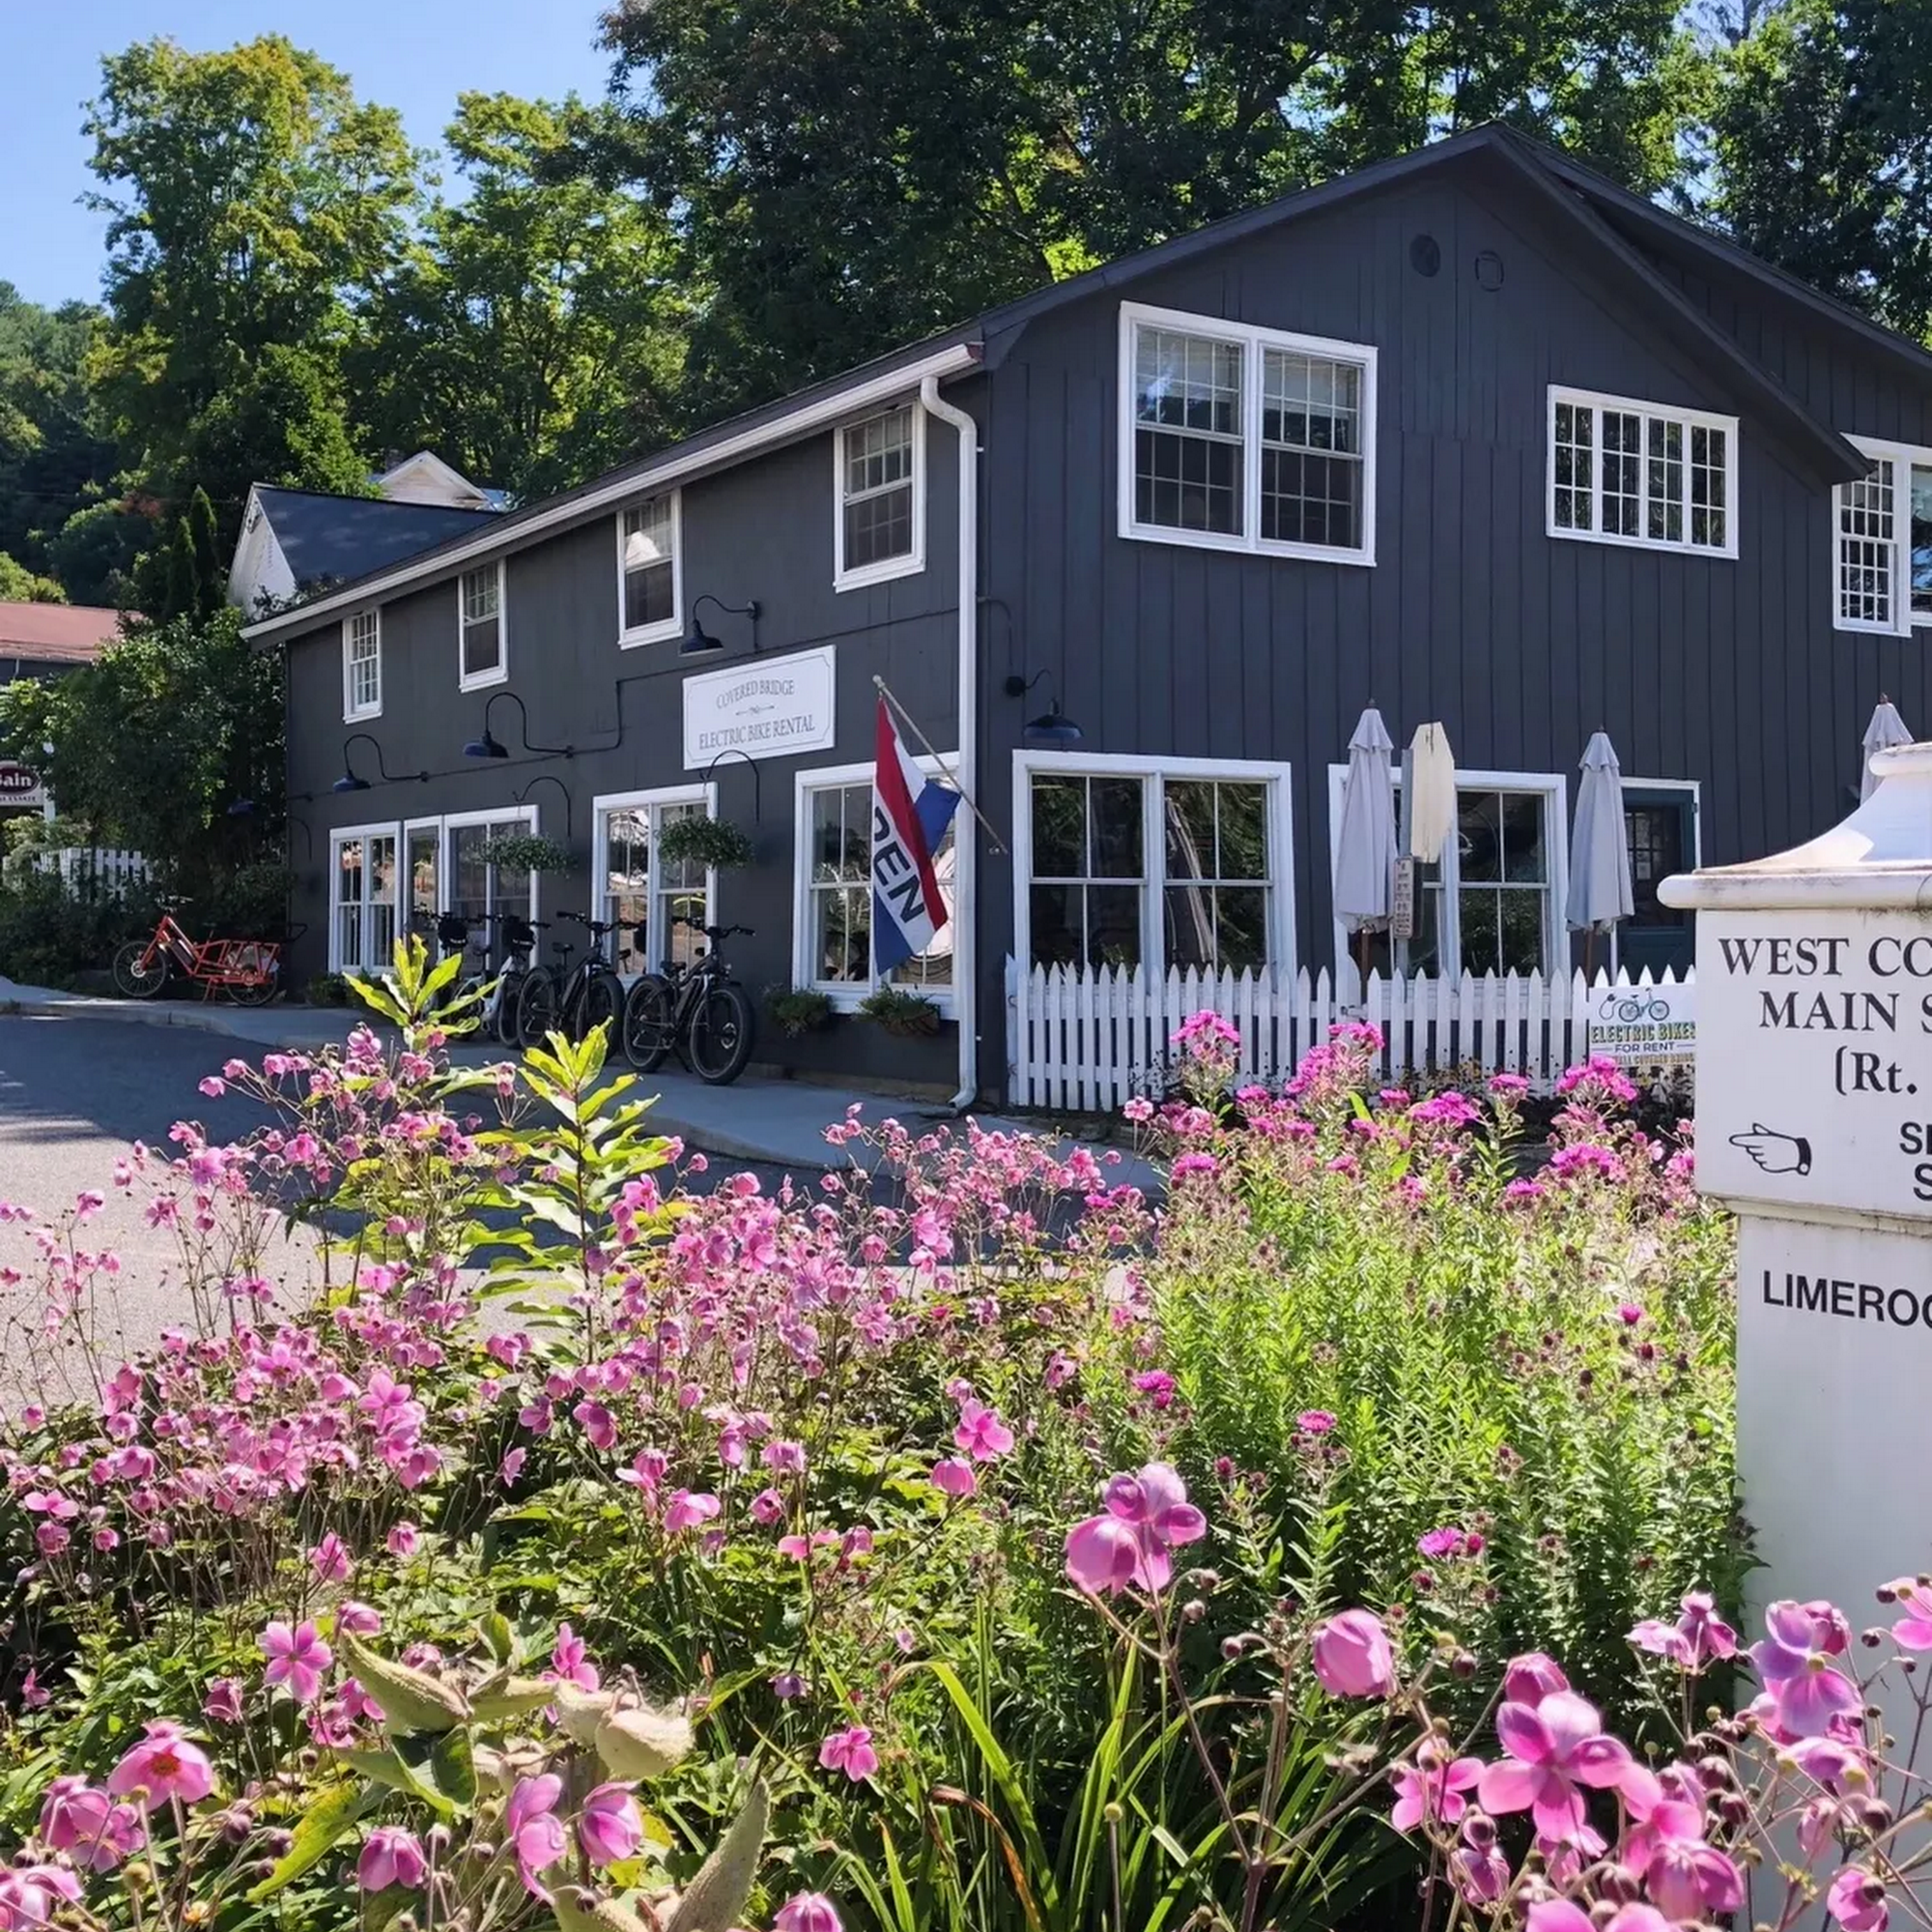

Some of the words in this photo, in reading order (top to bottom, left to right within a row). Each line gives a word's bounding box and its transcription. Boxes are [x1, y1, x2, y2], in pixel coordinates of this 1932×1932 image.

[716, 680, 758, 709] COVERED
[759, 679, 795, 696] BRIDGE
[699, 724, 747, 750] ELECTRIC
[748, 722, 772, 742] BIKE
[773, 715, 815, 737] RENTAL
[0, 772, 32, 787] ain
[1718, 937, 1850, 976] WEST
[1868, 937, 1932, 977] CO
[1758, 991, 1900, 1032] MAIN
[1591, 1024, 1655, 1043] ELECTRIC
[1615, 1044, 1640, 1053] FOR
[1643, 1041, 1675, 1052] RENT
[1835, 1046, 1918, 1095] (Rt.
[1899, 1122, 1932, 1155] S
